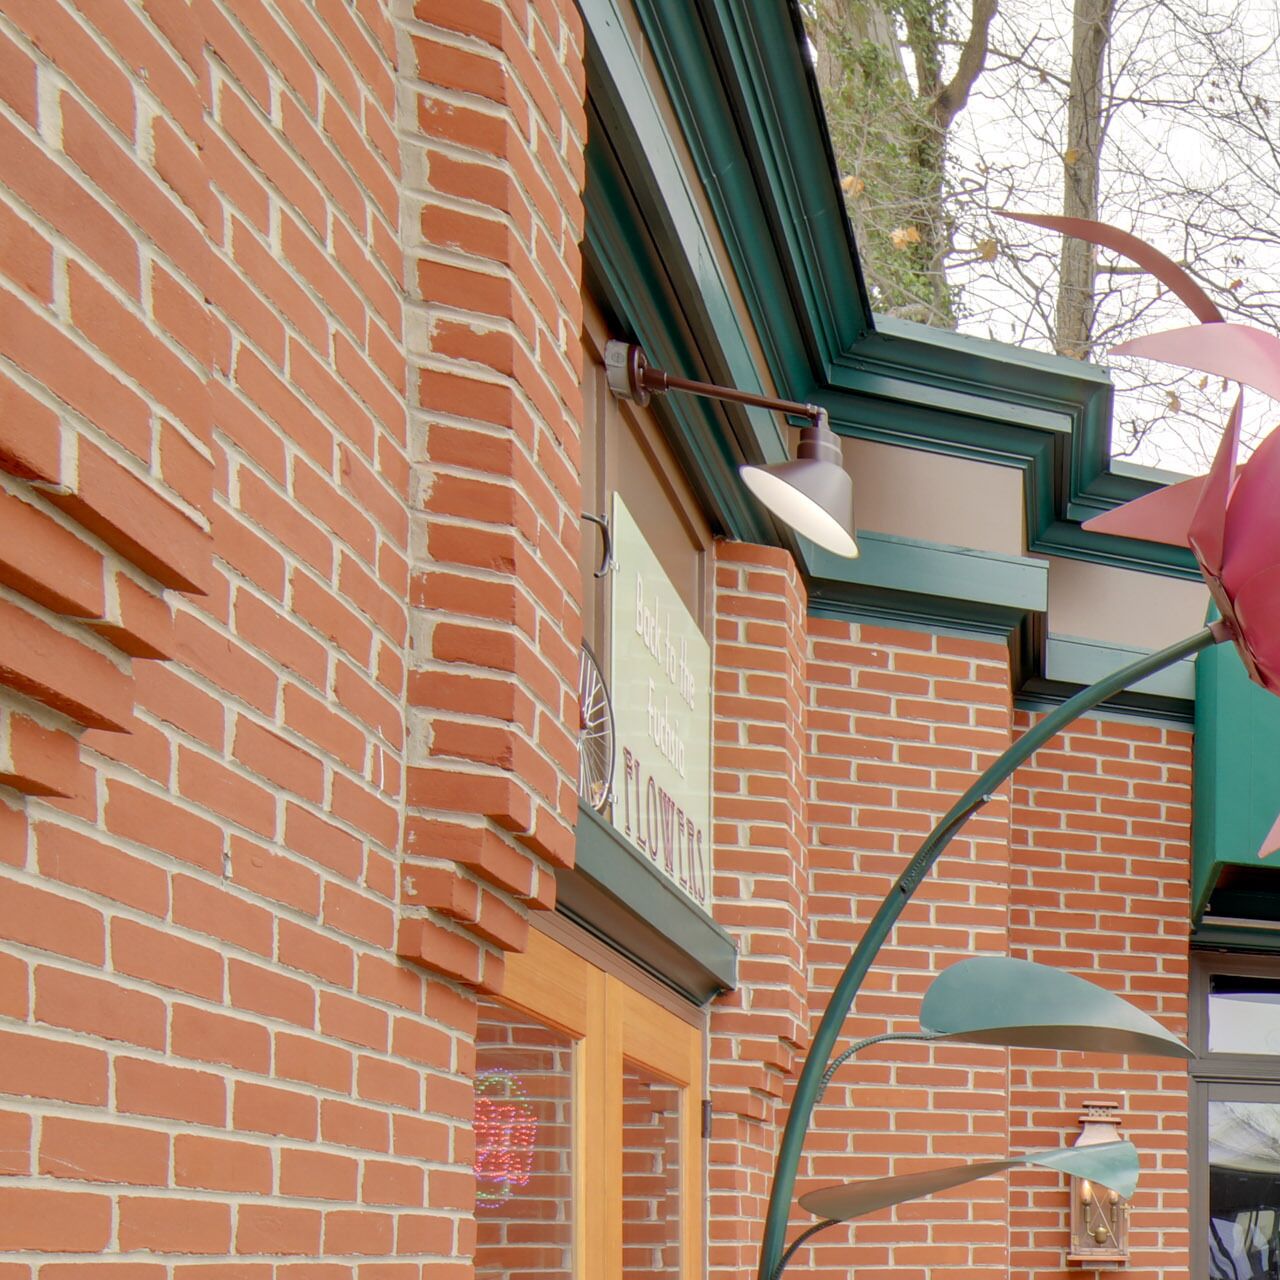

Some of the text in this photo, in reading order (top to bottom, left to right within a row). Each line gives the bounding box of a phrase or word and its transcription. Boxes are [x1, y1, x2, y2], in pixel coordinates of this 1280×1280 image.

[635, 573, 695, 711] Back to the
[648, 678, 686, 777] Fuchsia
[623, 747, 706, 905] FLOWERS
